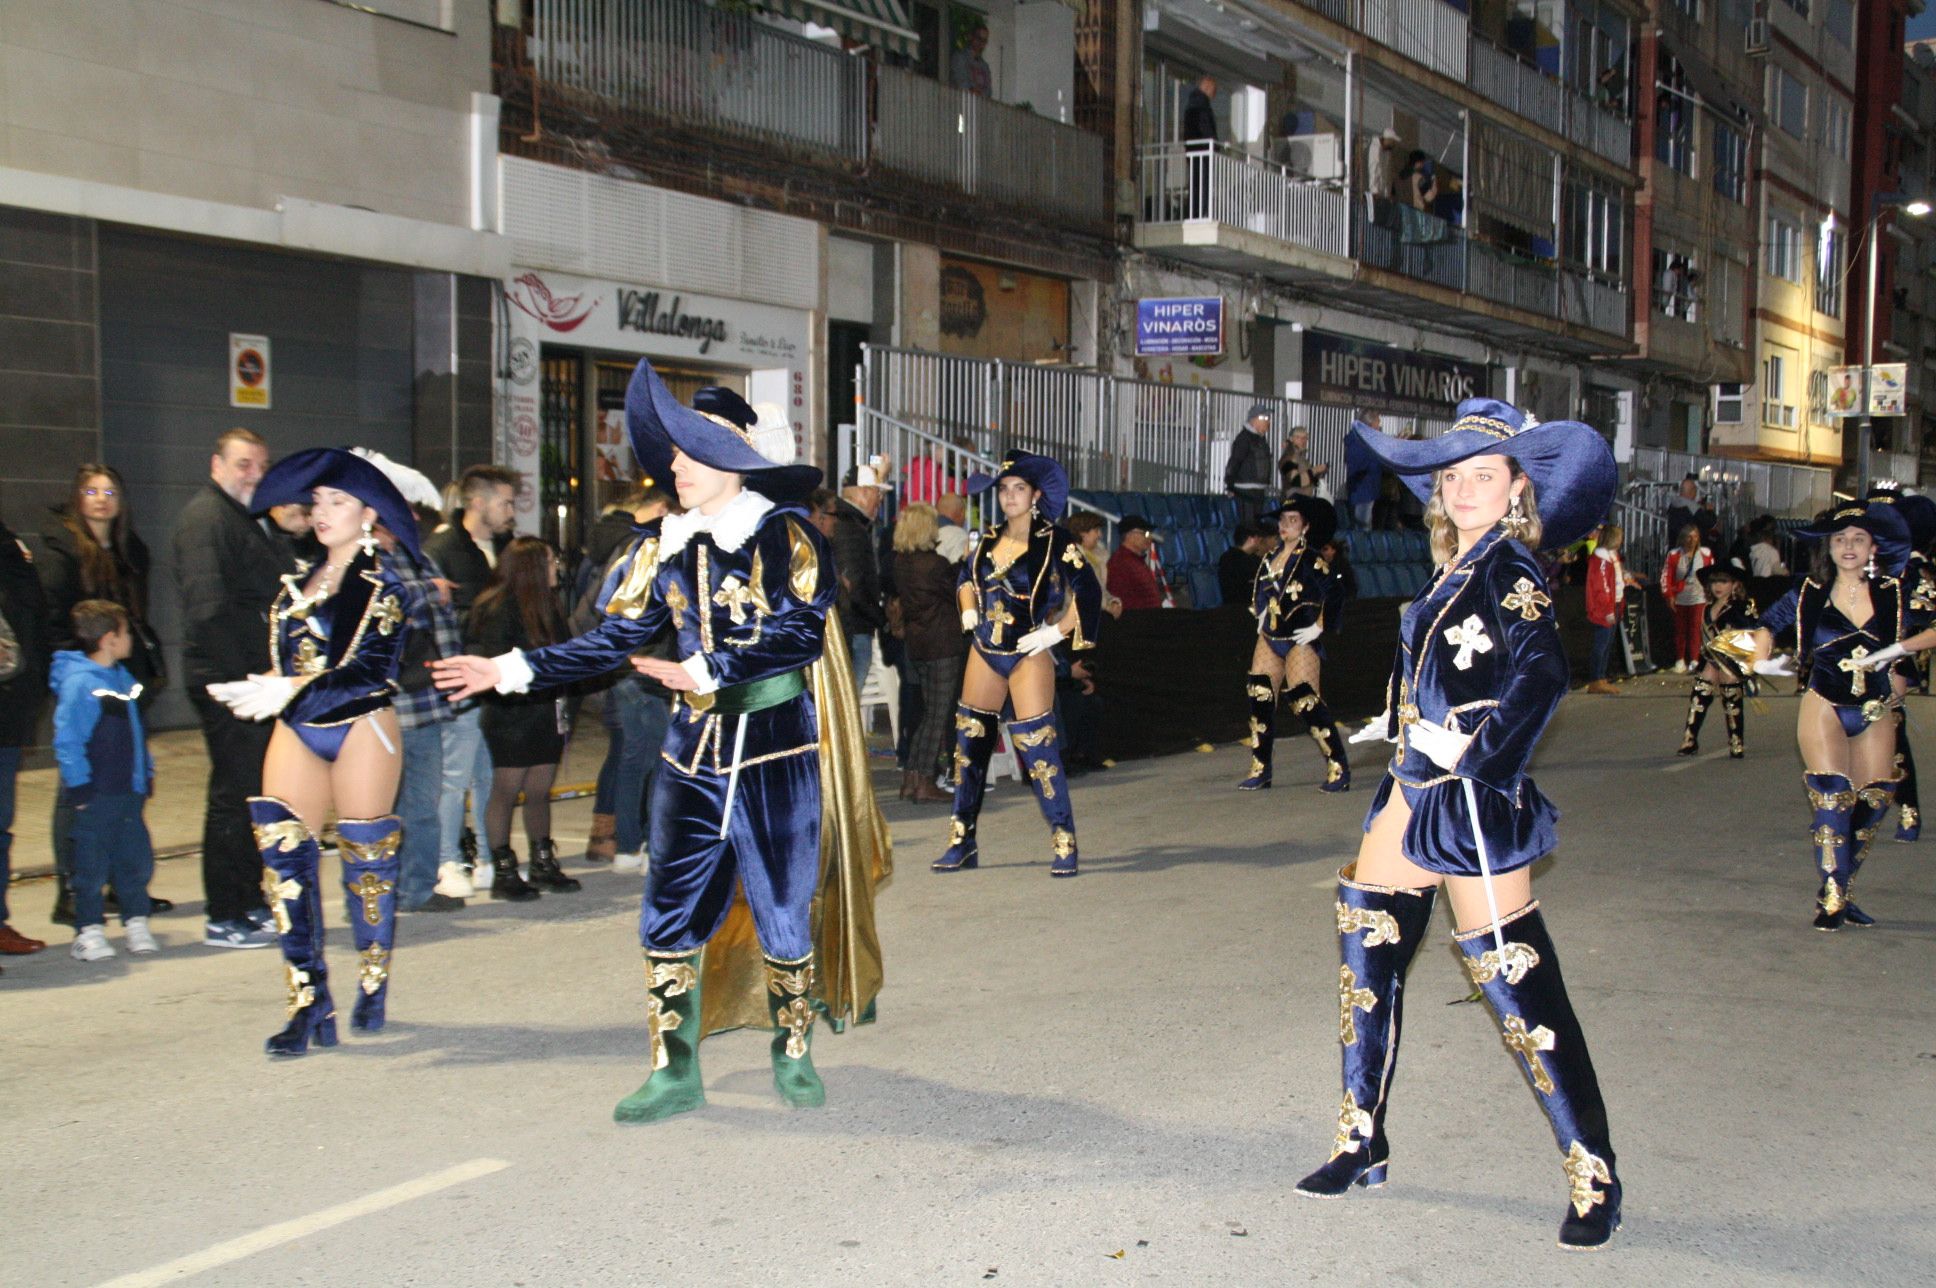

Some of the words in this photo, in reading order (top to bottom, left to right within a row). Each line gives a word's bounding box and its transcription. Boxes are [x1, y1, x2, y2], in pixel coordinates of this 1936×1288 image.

[617, 287, 727, 354] Villalonga
[1143, 317, 1217, 334] VINARÒS
[1154, 303, 1204, 317] HIPER
[1321, 350, 1387, 393] HIPER
[1391, 363, 1474, 404] VINARÒS
